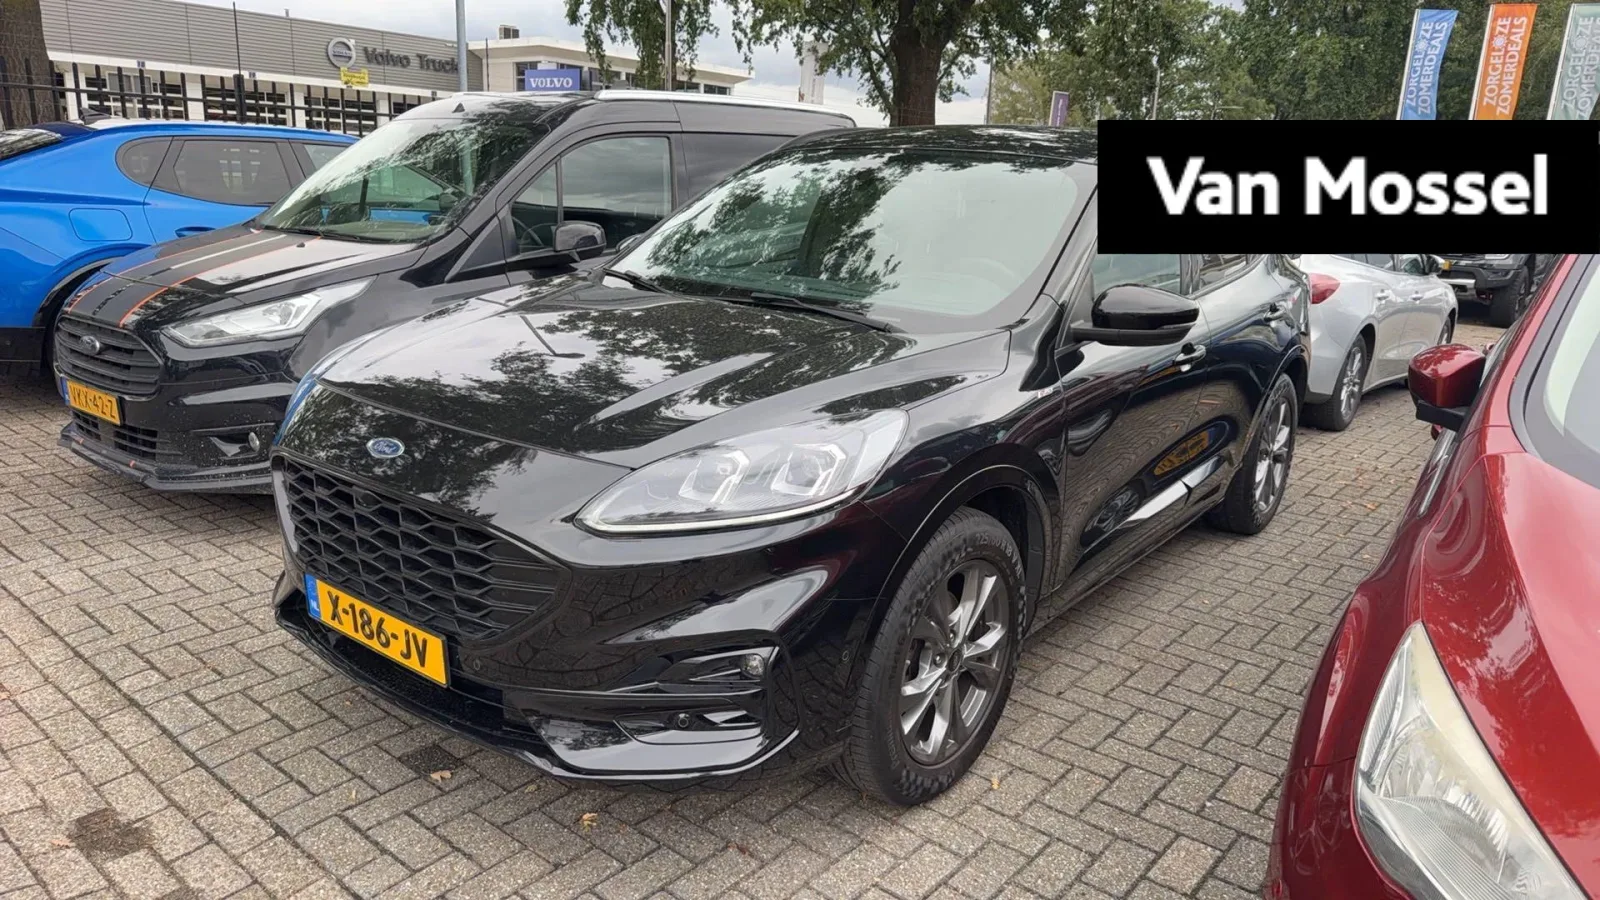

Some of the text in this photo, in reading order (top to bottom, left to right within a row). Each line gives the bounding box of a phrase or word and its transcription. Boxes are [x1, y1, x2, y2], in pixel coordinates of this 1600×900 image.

[363, 46, 411, 68] Volvo
[529, 77, 573, 88] VOLVO
[1417, 22, 1449, 115] ZOMERDEALS
[1497, 16, 1528, 115] ZOMERDEALS
[327, 590, 428, 668] X-186-JV
